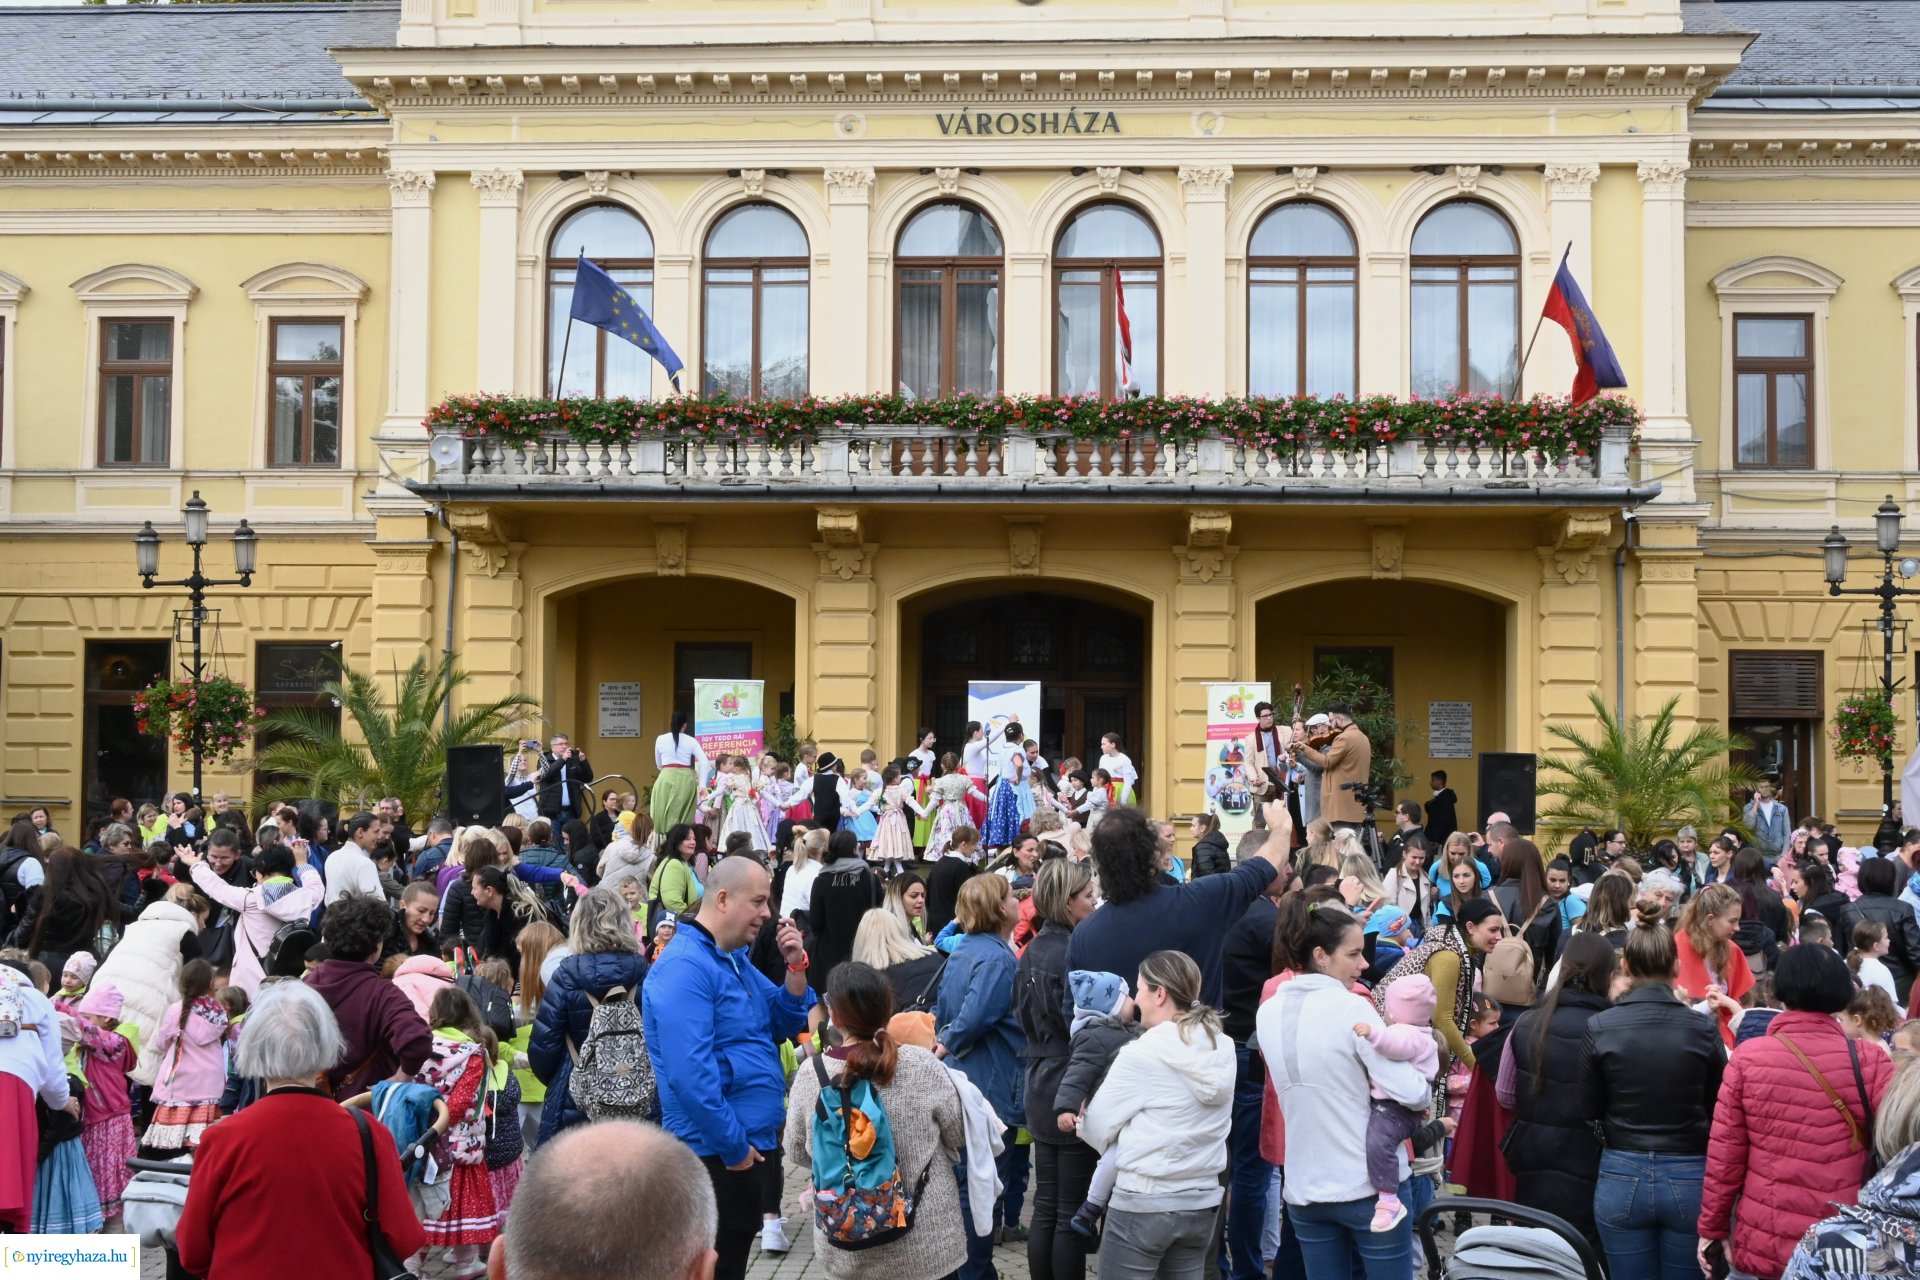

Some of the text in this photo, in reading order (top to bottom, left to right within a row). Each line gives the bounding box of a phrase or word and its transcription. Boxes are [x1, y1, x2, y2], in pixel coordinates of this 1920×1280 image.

[935, 106, 1121, 135] VÁROSHÁZA
[702, 739, 757, 750] REFERENCIA
[704, 748, 752, 758] NTÉZMÉNY
